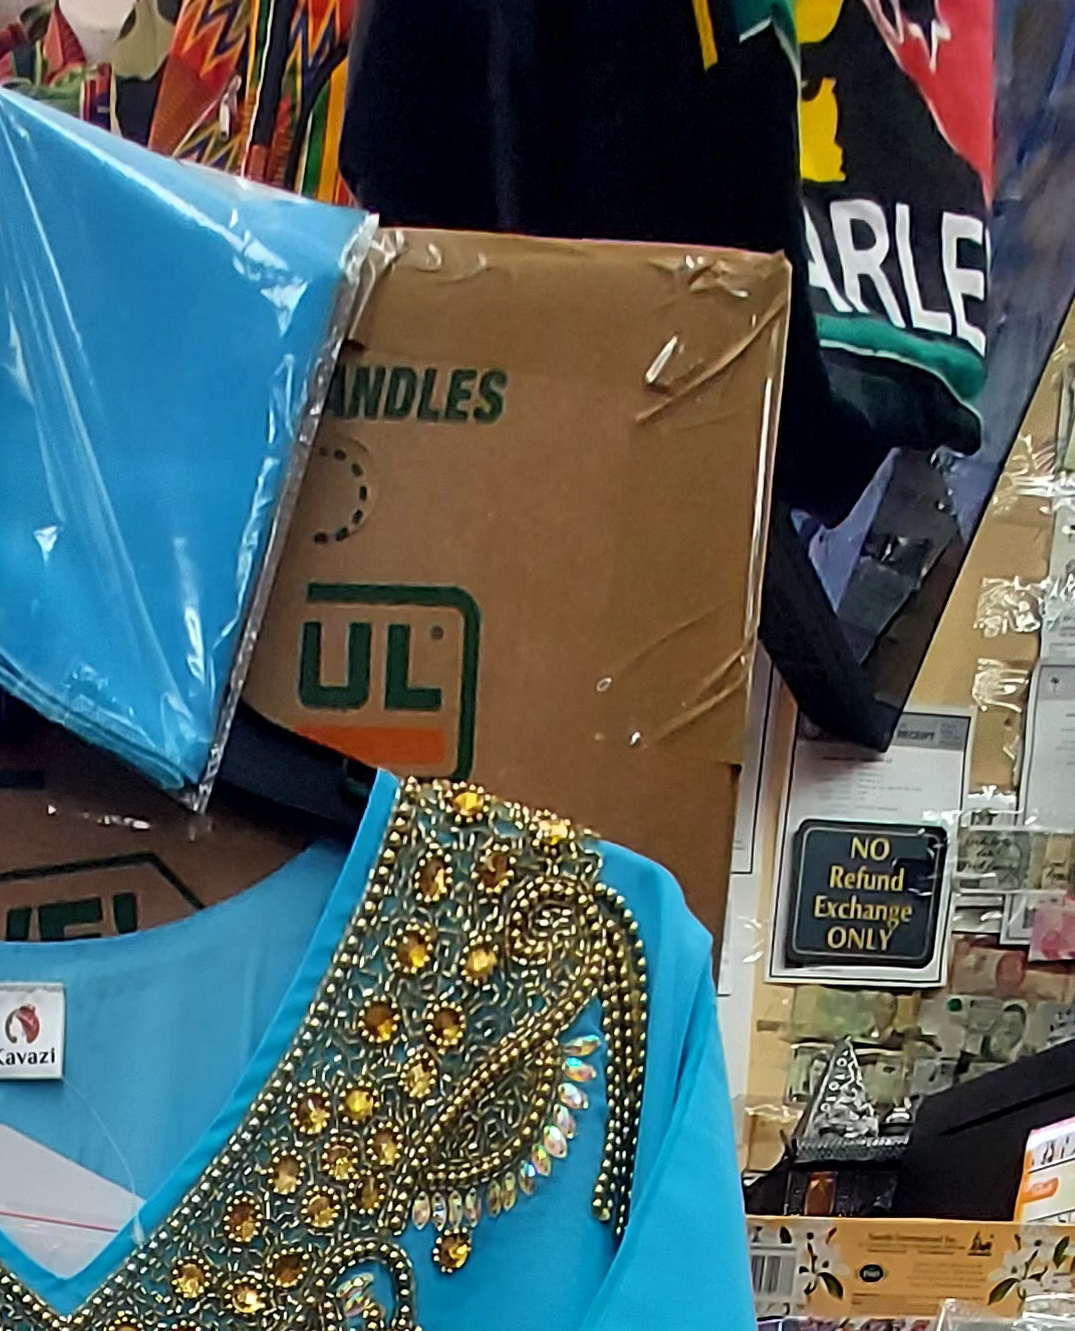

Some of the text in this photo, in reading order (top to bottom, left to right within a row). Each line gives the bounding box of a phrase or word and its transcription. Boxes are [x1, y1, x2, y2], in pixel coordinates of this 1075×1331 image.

[802, 199, 990, 358] ARLE
[299, 621, 442, 711] UL
[851, 837, 890, 861] NO
[829, 865, 905, 891] Refund
[814, 895, 913, 930] Exchange
[827, 926, 897, 951] ONLY
